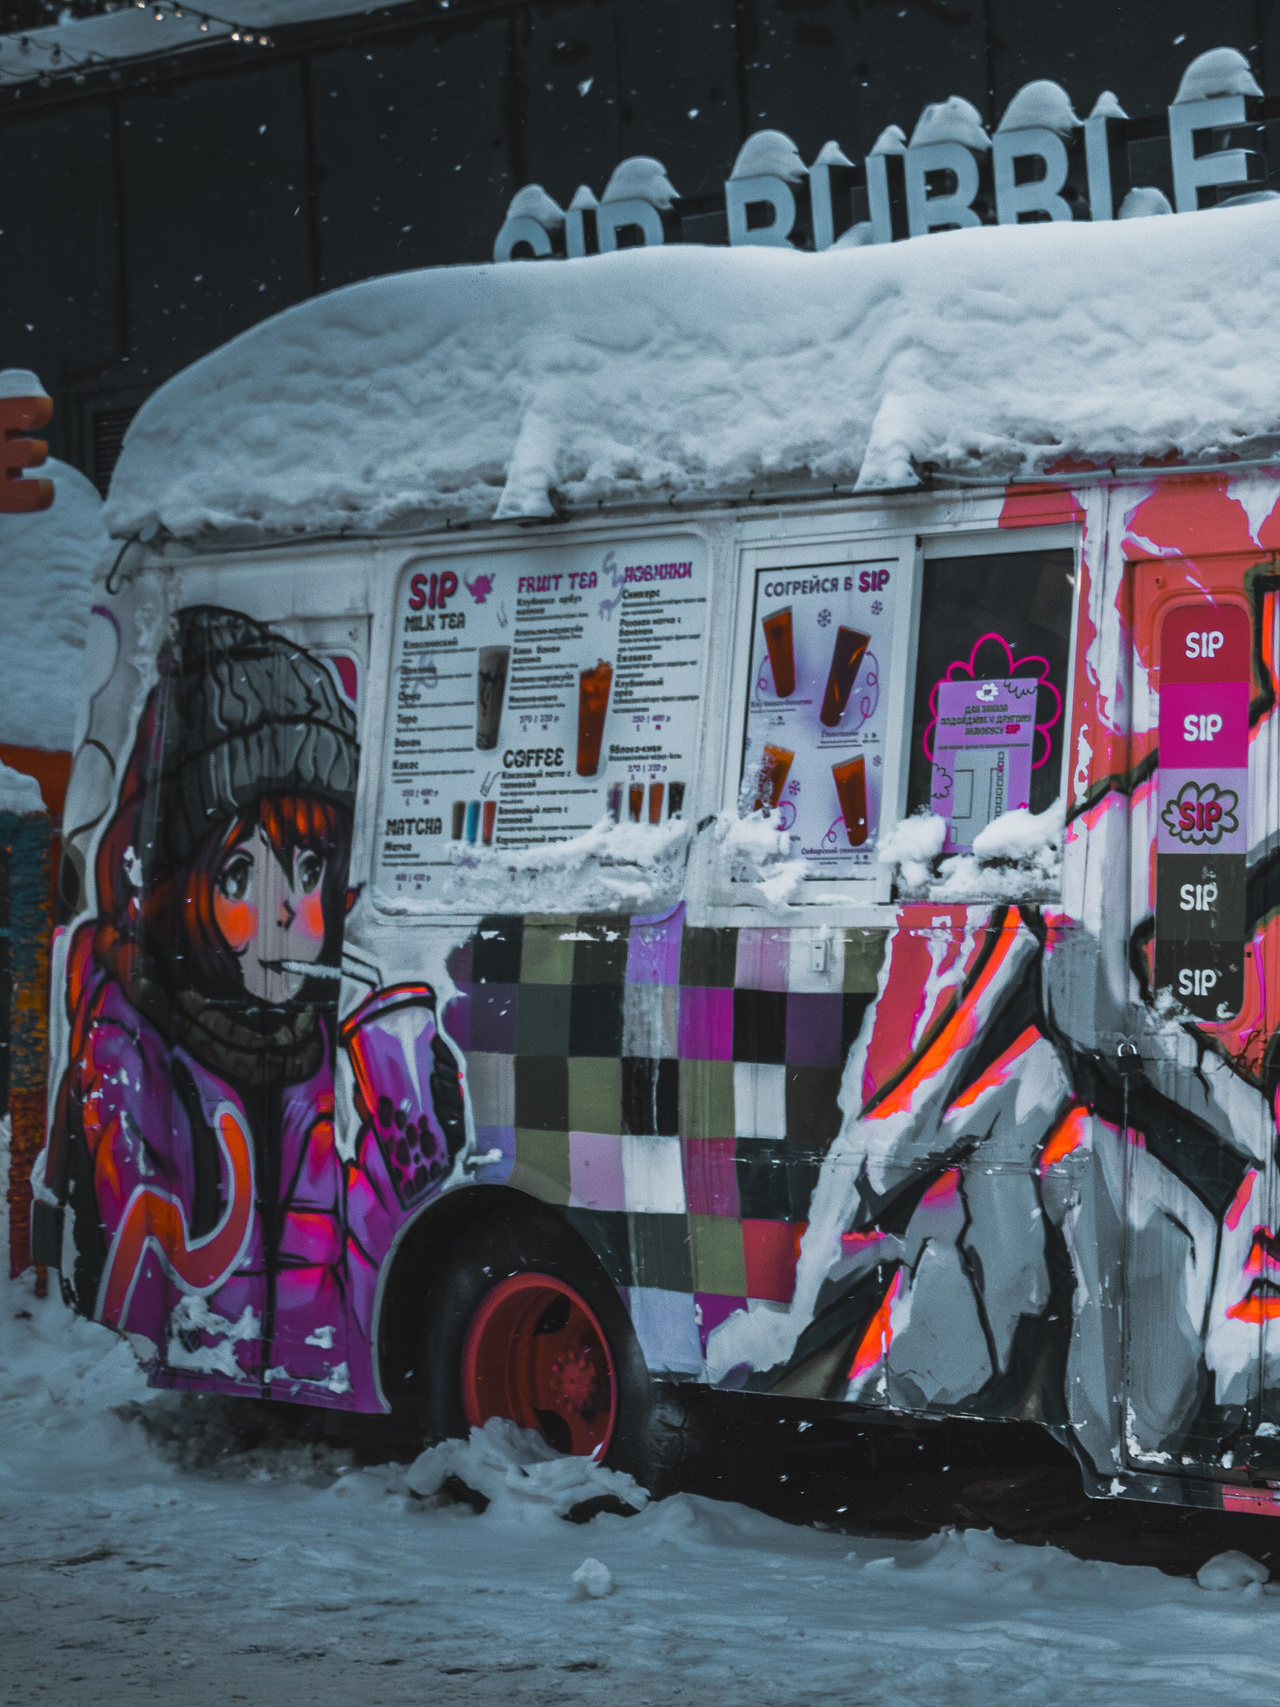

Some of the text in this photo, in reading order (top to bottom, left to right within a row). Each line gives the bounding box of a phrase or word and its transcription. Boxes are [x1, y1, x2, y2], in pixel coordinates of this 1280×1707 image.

[408, 570, 459, 611] SIP
[517, 571, 597, 594] FRUIT TEA
[764, 569, 890, 598] СОГРЕЙСЯ В SIP
[404, 612, 466, 632] MILK TEA
[1185, 631, 1224, 658] SIP
[1183, 714, 1222, 741] SIP
[503, 747, 564, 769] COFFEE
[385, 817, 443, 836] MATCHA
[1178, 801, 1222, 831] SIP
[1179, 884, 1218, 911] SIP
[1178, 969, 1217, 996] SIP
